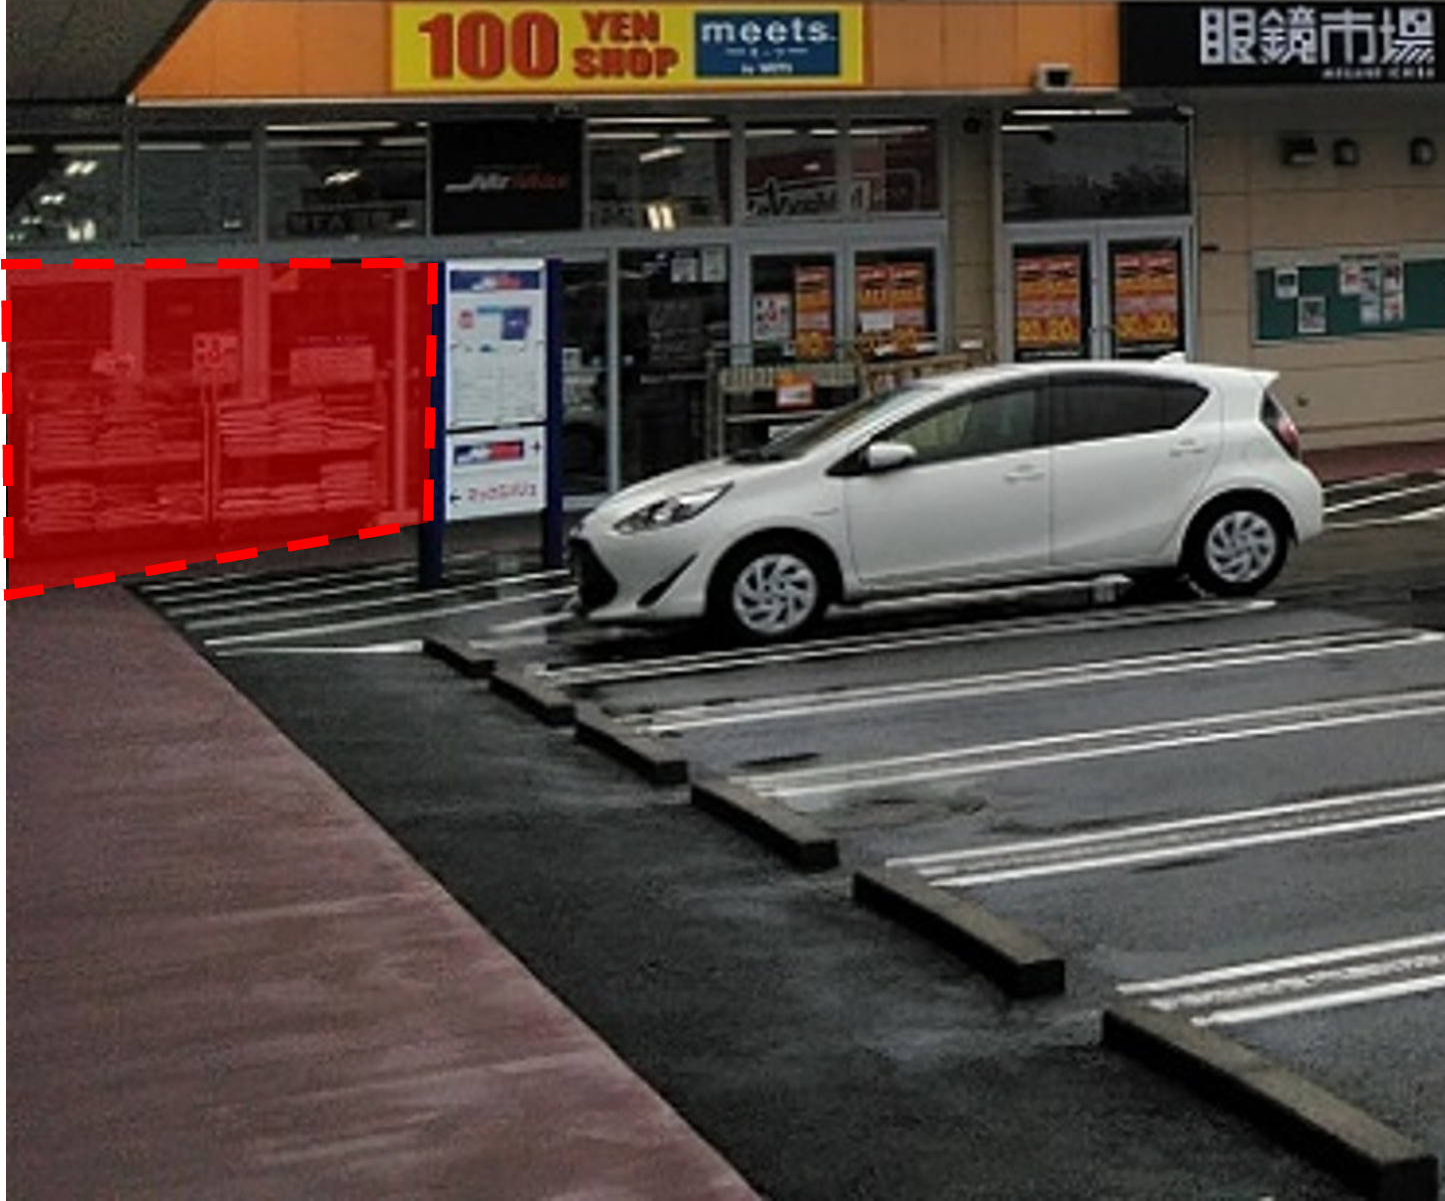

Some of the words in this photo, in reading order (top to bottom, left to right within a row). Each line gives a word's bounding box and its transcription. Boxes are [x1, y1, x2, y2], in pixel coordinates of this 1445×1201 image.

[418, 11, 560, 80] 100
[579, 11, 660, 43] YEN
[1200, 6, 1435, 65] 眼鏡市場
[572, 47, 680, 78] SHOP
